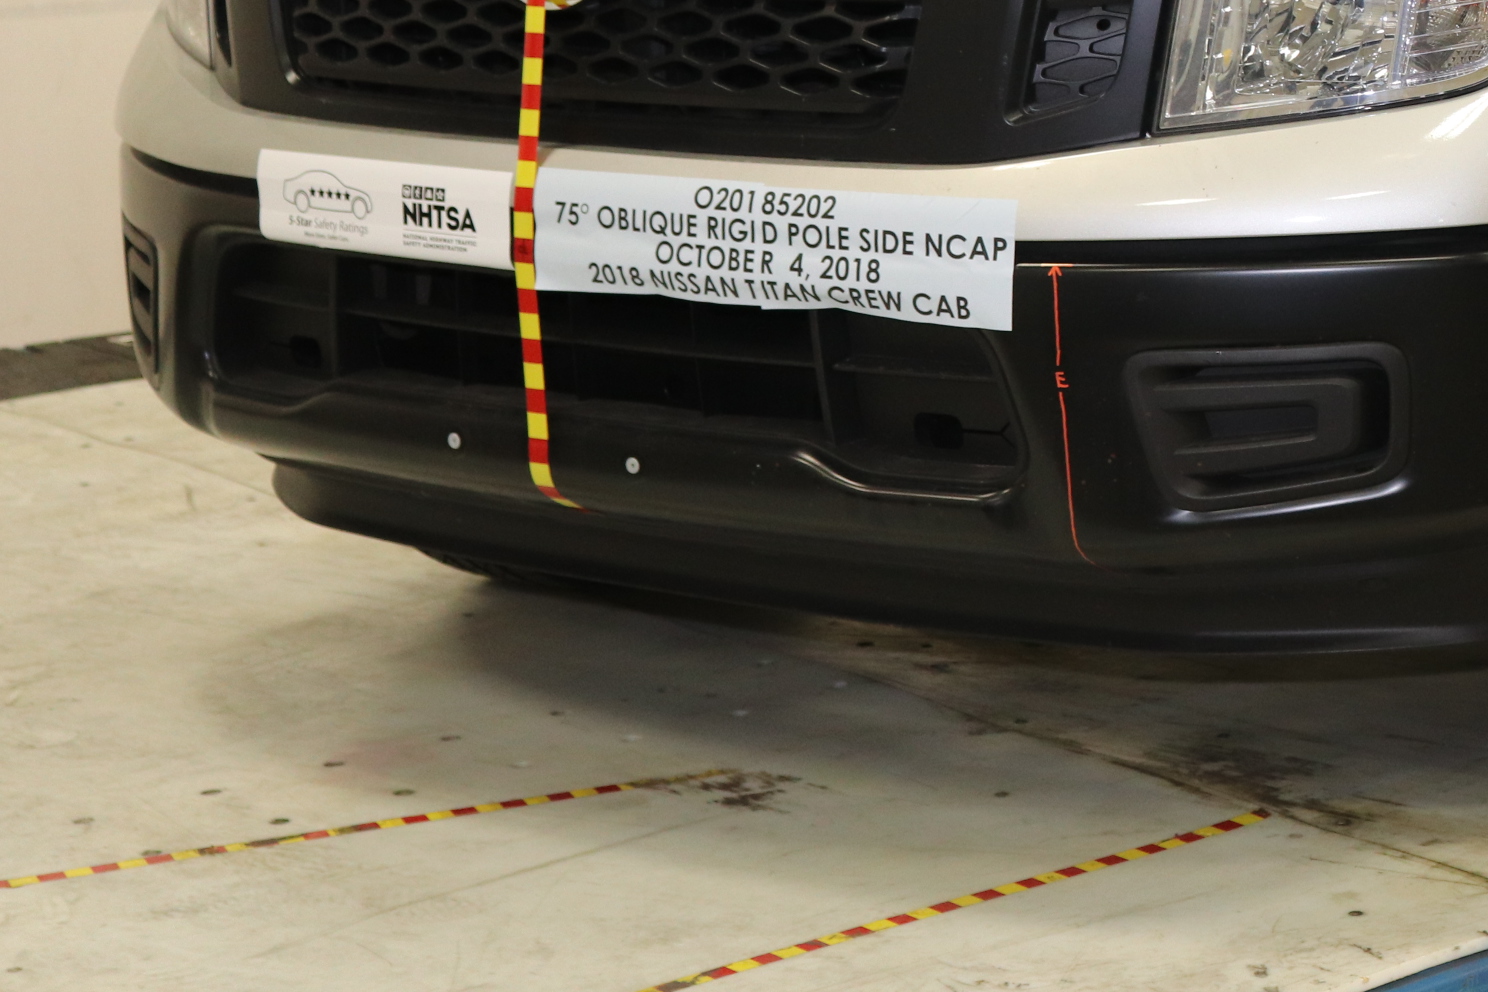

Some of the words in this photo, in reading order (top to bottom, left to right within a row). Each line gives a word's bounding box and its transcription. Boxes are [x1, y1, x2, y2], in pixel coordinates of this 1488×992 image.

[314, 217, 338, 233] Safety
[340, 220, 369, 237] Ratings
[402, 201, 477, 233] NHTSA
[597, 205, 698, 237] OBLIQUE
[707, 216, 778, 244] RIGID
[788, 223, 850, 250] POLE
[859, 228, 915, 255] SIDE
[925, 233, 1008, 261] NCAP
[655, 240, 774, 274] OCTOBER
[789, 253, 810, 281] 4,
[819, 255, 881, 284] 2018
[588, 262, 645, 287] 2018
[649, 268, 740, 299] NISSAN
[744, 279, 821, 302] TITAN
[827, 285, 902, 312] CREW
[912, 292, 971, 320] CAB
